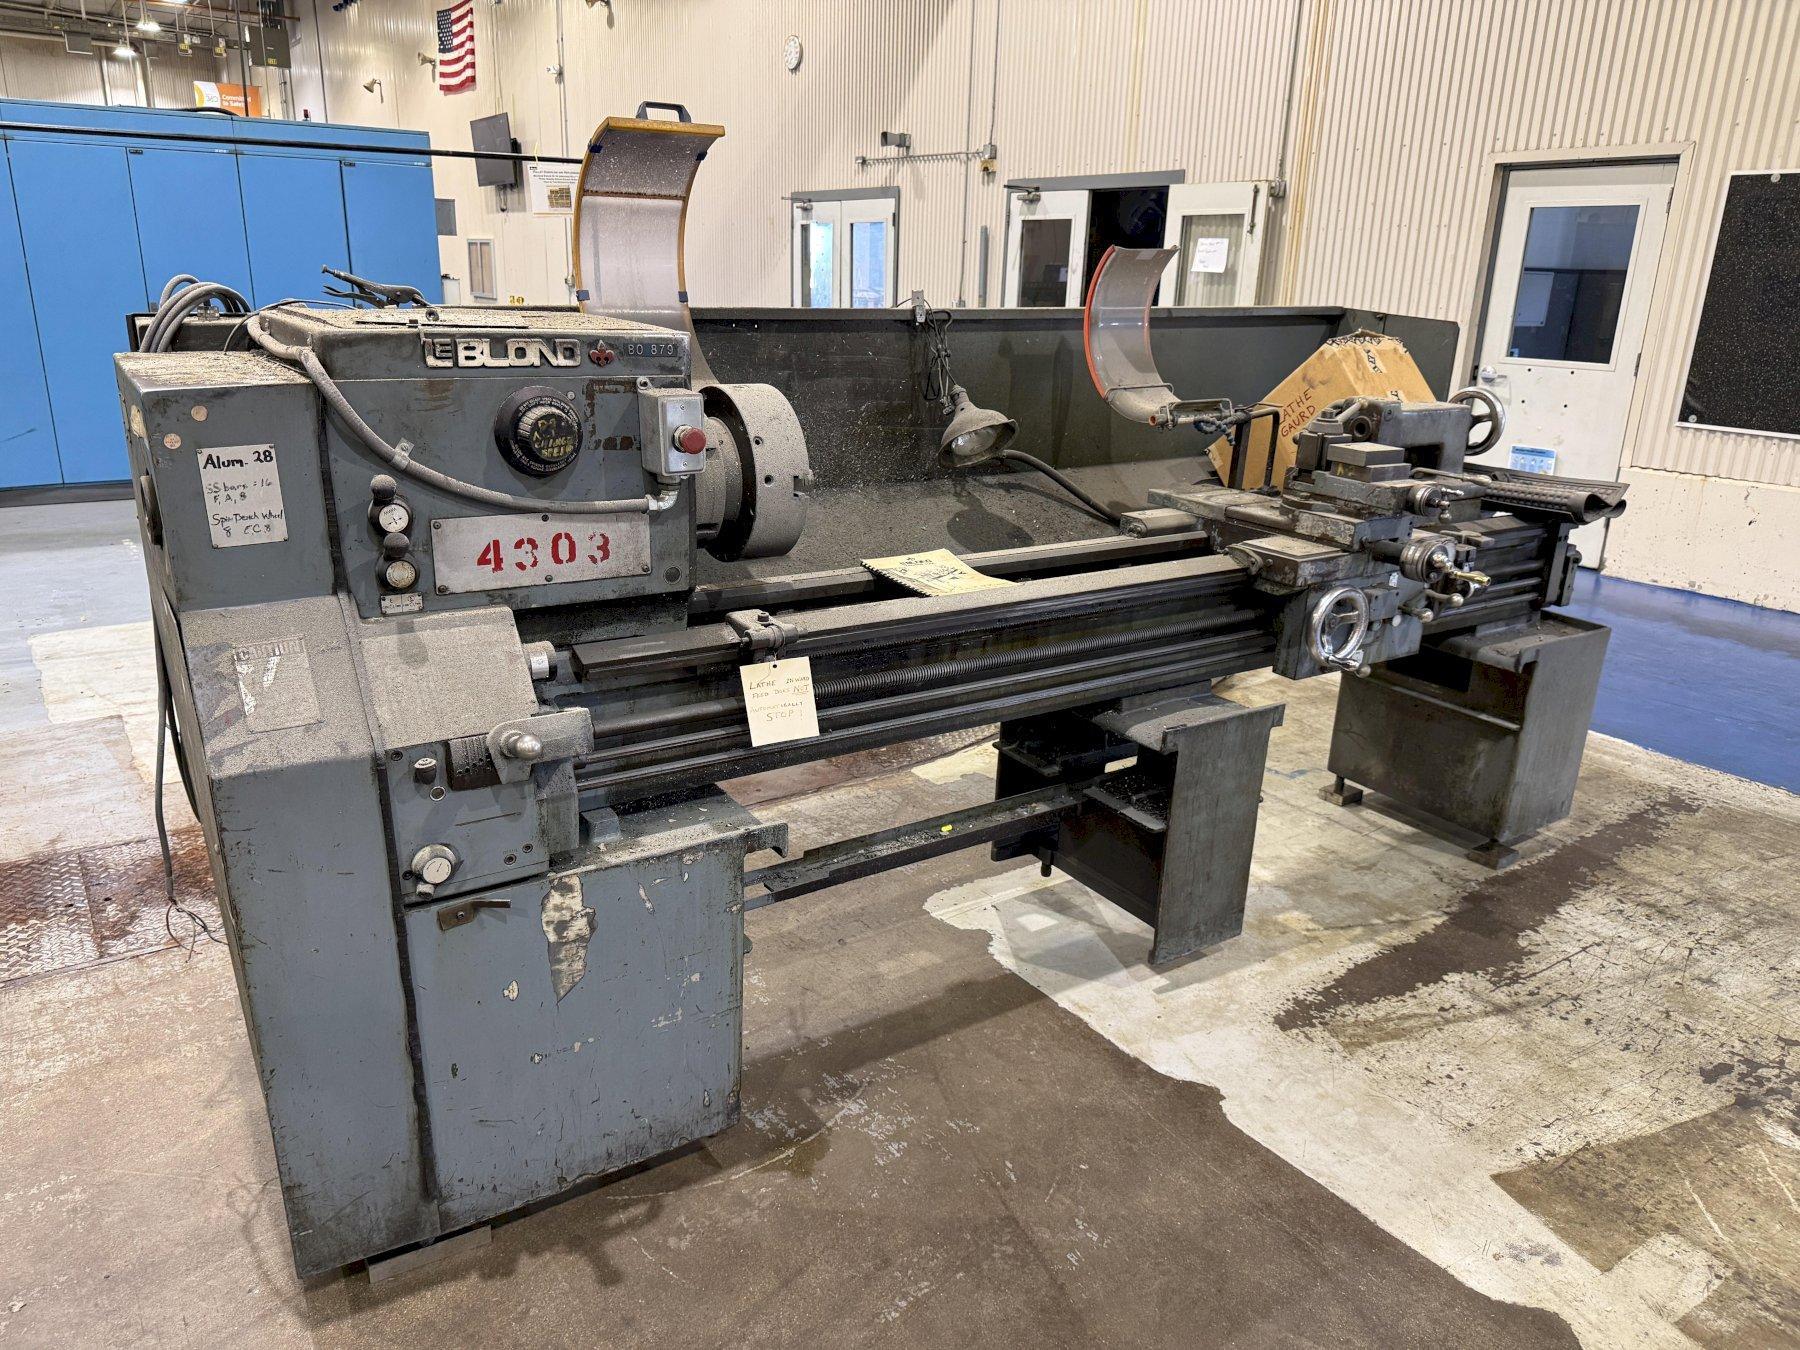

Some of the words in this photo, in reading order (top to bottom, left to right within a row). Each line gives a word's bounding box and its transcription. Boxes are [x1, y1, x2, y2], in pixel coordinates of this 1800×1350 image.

[651, 344, 674, 355] 879
[1281, 405, 1316, 438] GAURD
[252, 449, 274, 464] 28
[476, 532, 611, 574] 4303
[749, 679, 777, 690] LATHE
[793, 684, 810, 693] NOT
[766, 709, 794, 722] STOP
